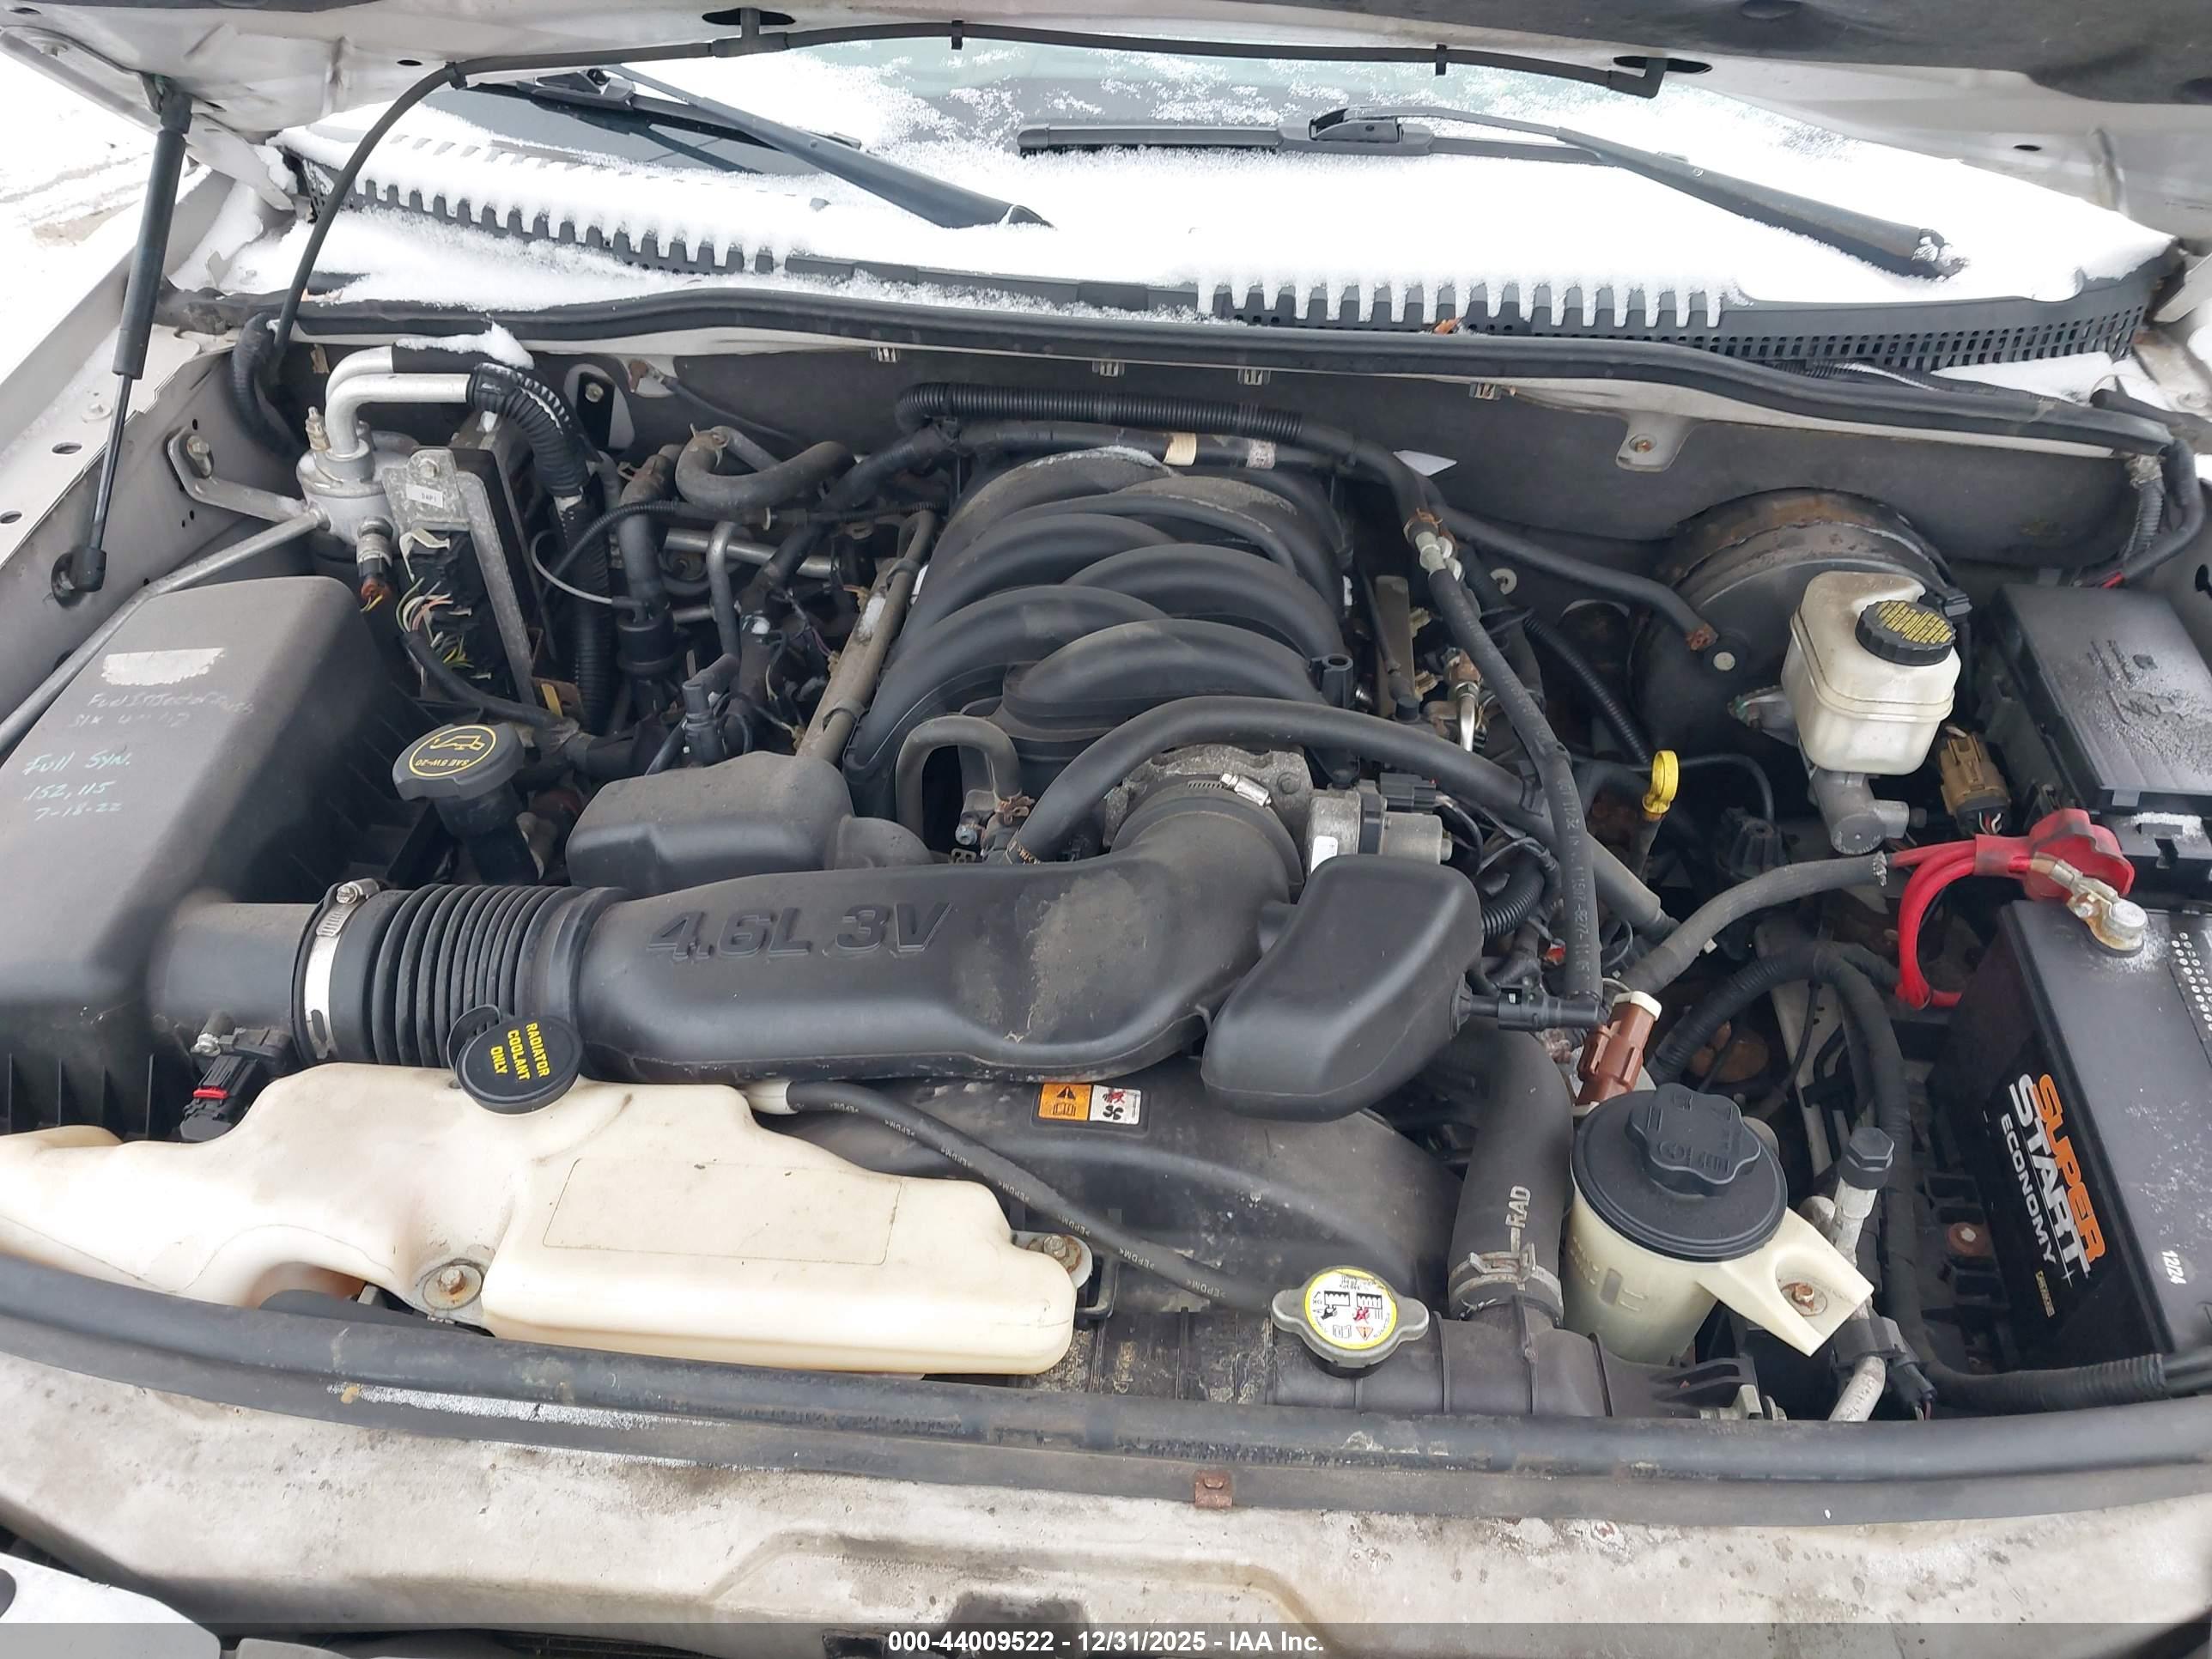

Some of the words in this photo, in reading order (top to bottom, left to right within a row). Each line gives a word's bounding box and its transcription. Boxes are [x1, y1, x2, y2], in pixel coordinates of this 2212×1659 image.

[22, 750, 75, 775] Full
[646, 905, 812, 961] 4.6L
[835, 902, 955, 956] 3V
[490, 1045, 508, 1074] ONLY
[507, 1030, 532, 1081] COOLANT
[526, 1022, 550, 1078] RADIATOR
[2000, 1113, 2057, 1265] ECONOMY
[2008, 1073, 2092, 1279] START
[2031, 1073, 2106, 1264] SUPER
[1505, 1185, 1532, 1229] RAD
[2161, 1250, 2187, 1285] 12/24
